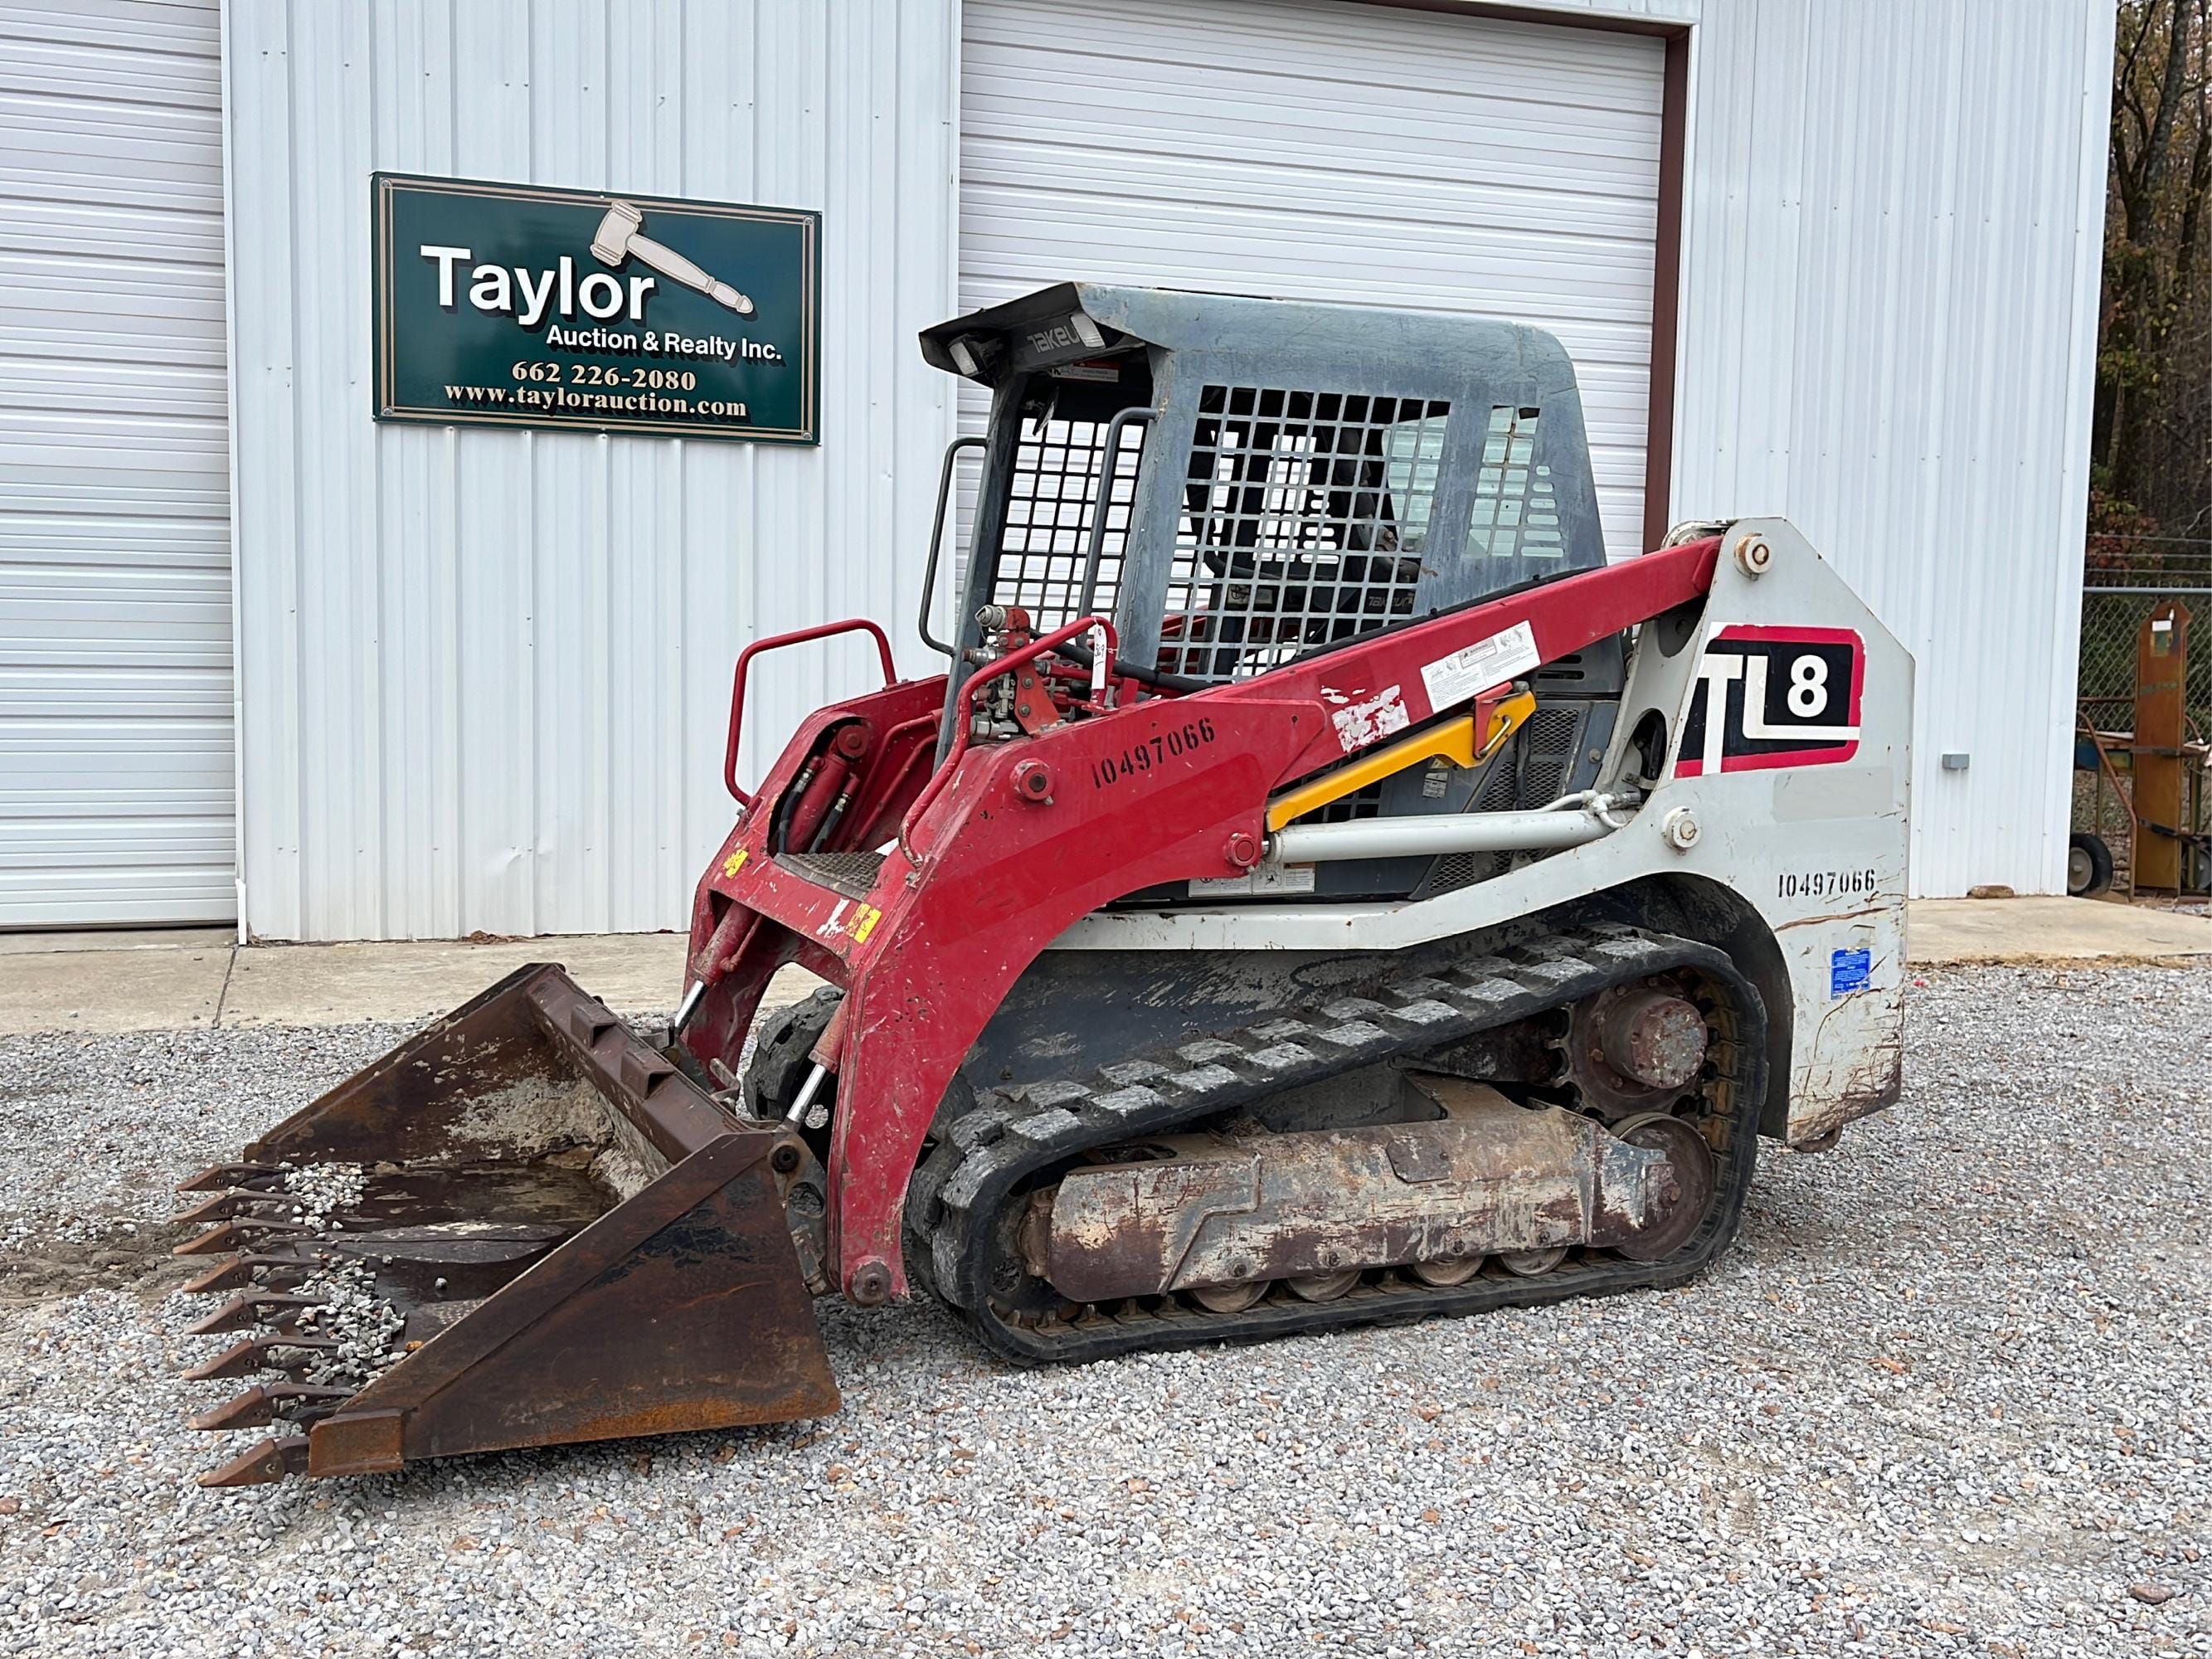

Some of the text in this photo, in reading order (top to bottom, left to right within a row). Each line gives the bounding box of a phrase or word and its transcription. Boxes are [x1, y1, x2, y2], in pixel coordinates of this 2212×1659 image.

[421, 245, 655, 326] Taylor
[546, 324, 782, 360] Auction & Realty Inc.
[511, 361, 697, 391] 662 226-2080
[444, 385, 746, 416] www.taylorauction.com
[1697, 654, 1860, 775] TL8
[1091, 717, 1215, 789] 10497066
[1778, 868, 1874, 898] 10497066
